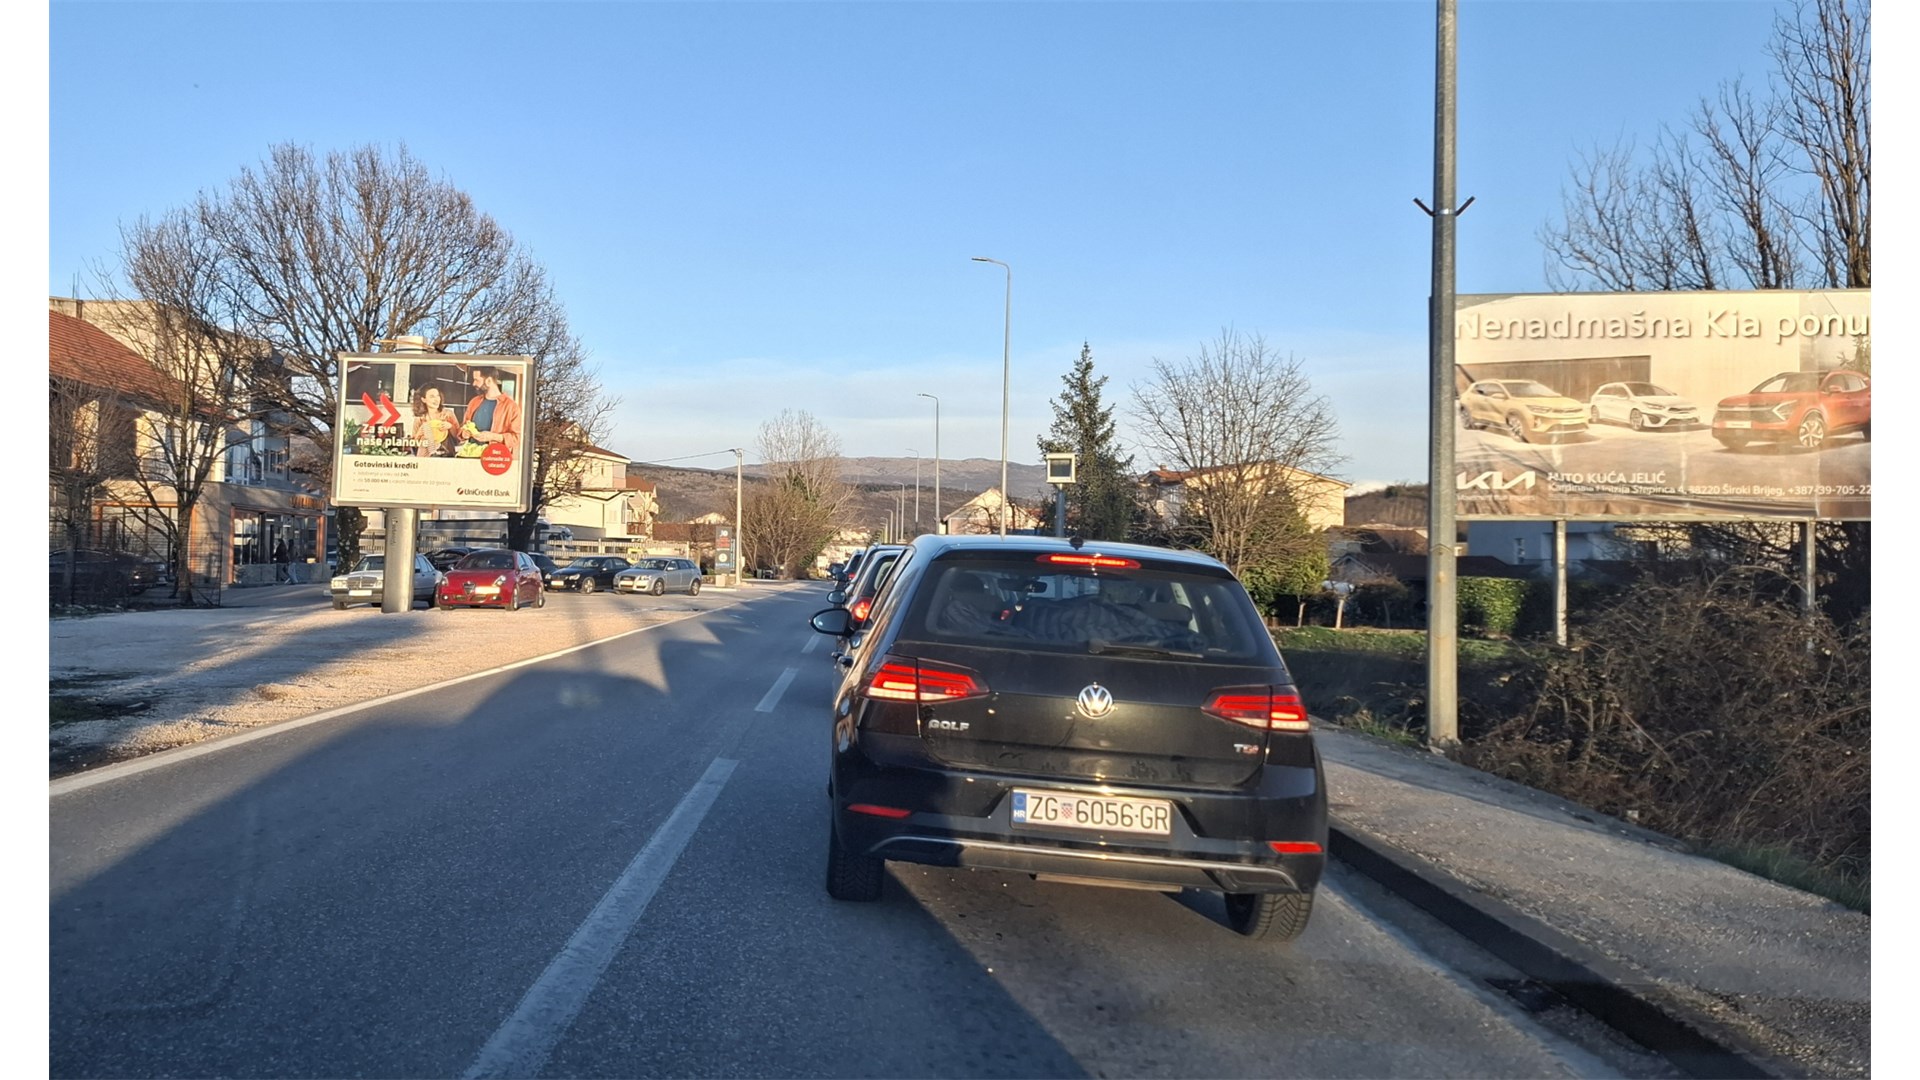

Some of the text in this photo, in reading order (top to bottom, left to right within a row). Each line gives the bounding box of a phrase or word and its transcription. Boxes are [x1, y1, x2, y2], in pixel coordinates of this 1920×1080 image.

[1455, 310, 1870, 344] Nenadmašna Kia ponu
[361, 423, 397, 435] Za sve
[356, 435, 429, 448] naše planove
[353, 460, 419, 470] Gotovinski krediti
[1587, 470, 1627, 484] KUĆA
[1629, 470, 1667, 484] JELIĆ
[464, 488, 493, 496] UniCredit
[1722, 484, 1751, 495] Široki
[928, 719, 970, 731] GOLF
[1013, 809, 1026, 819] HR
[1029, 795, 1058, 822] ZG
